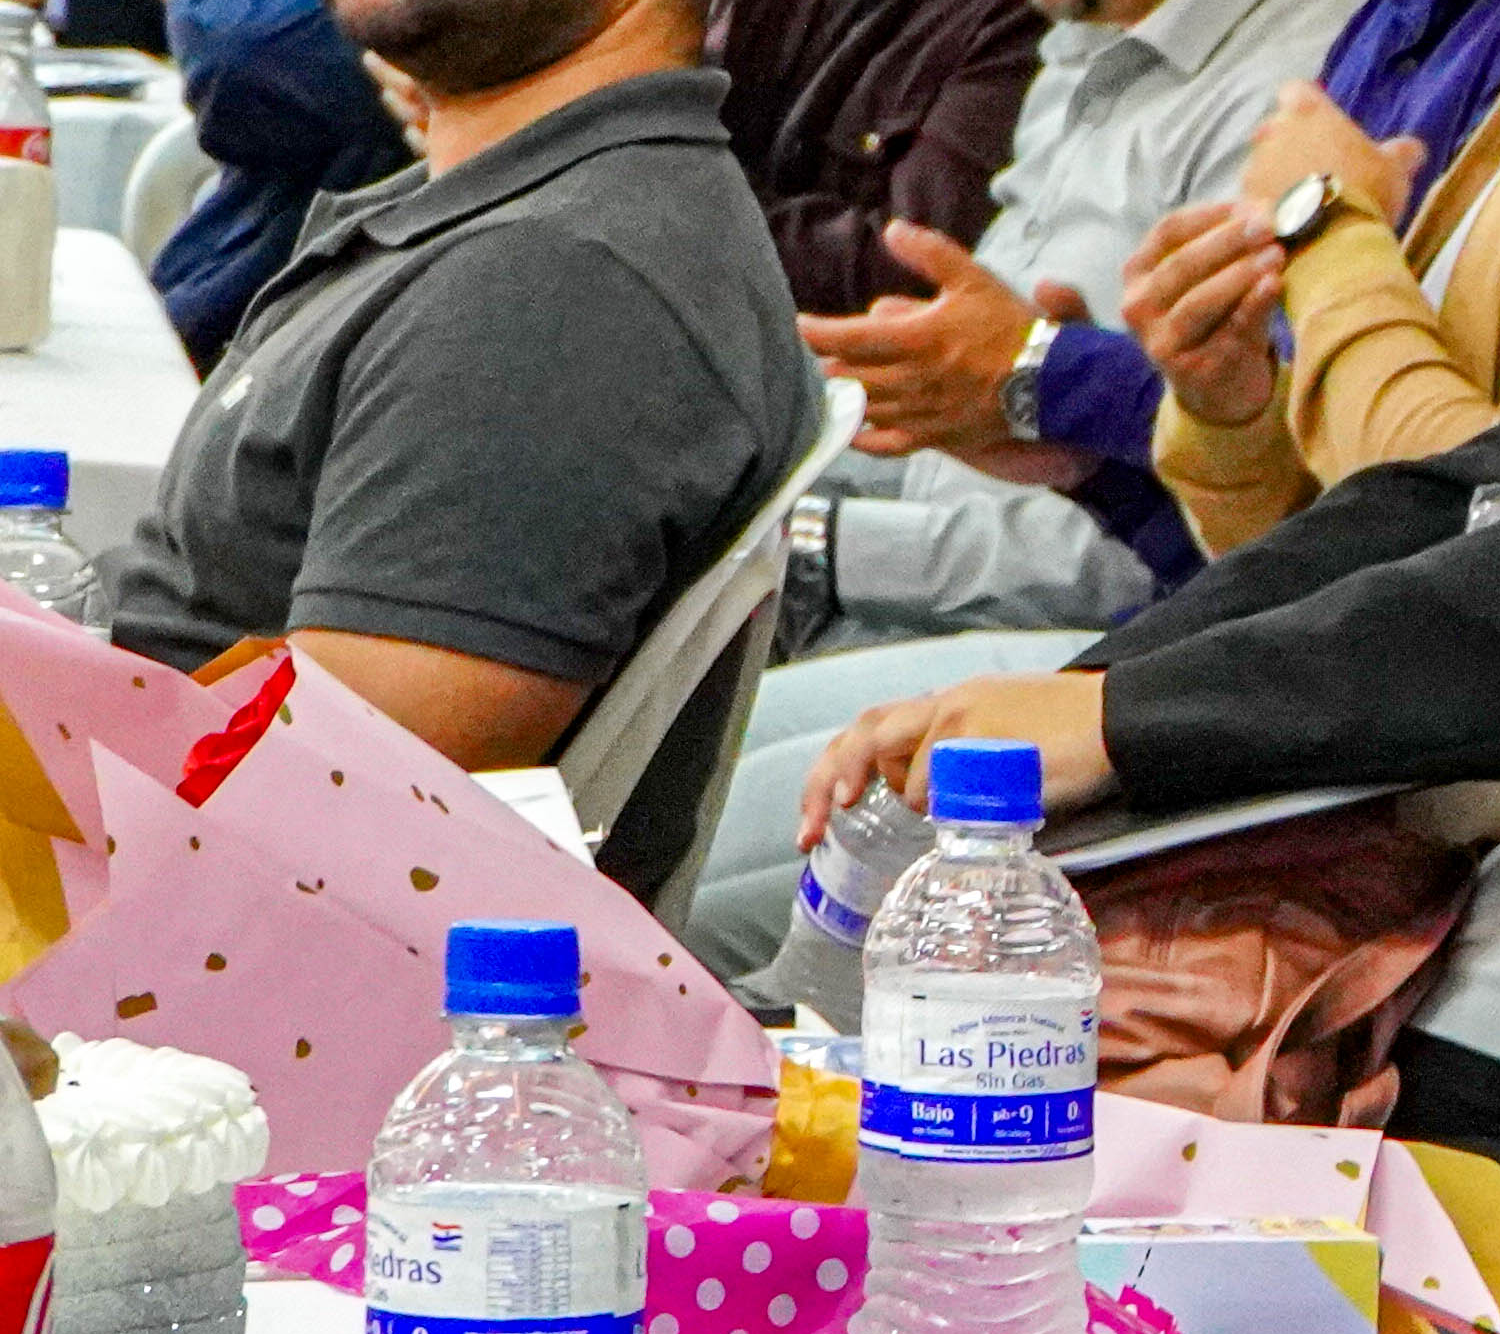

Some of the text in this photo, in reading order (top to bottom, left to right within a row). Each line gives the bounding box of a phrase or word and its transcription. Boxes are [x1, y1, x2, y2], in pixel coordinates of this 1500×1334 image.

[918, 1038, 1085, 1068] Las Piedras
[976, 1072, 1045, 1089] Sin Gas
[911, 1101, 955, 1125] Bajo
